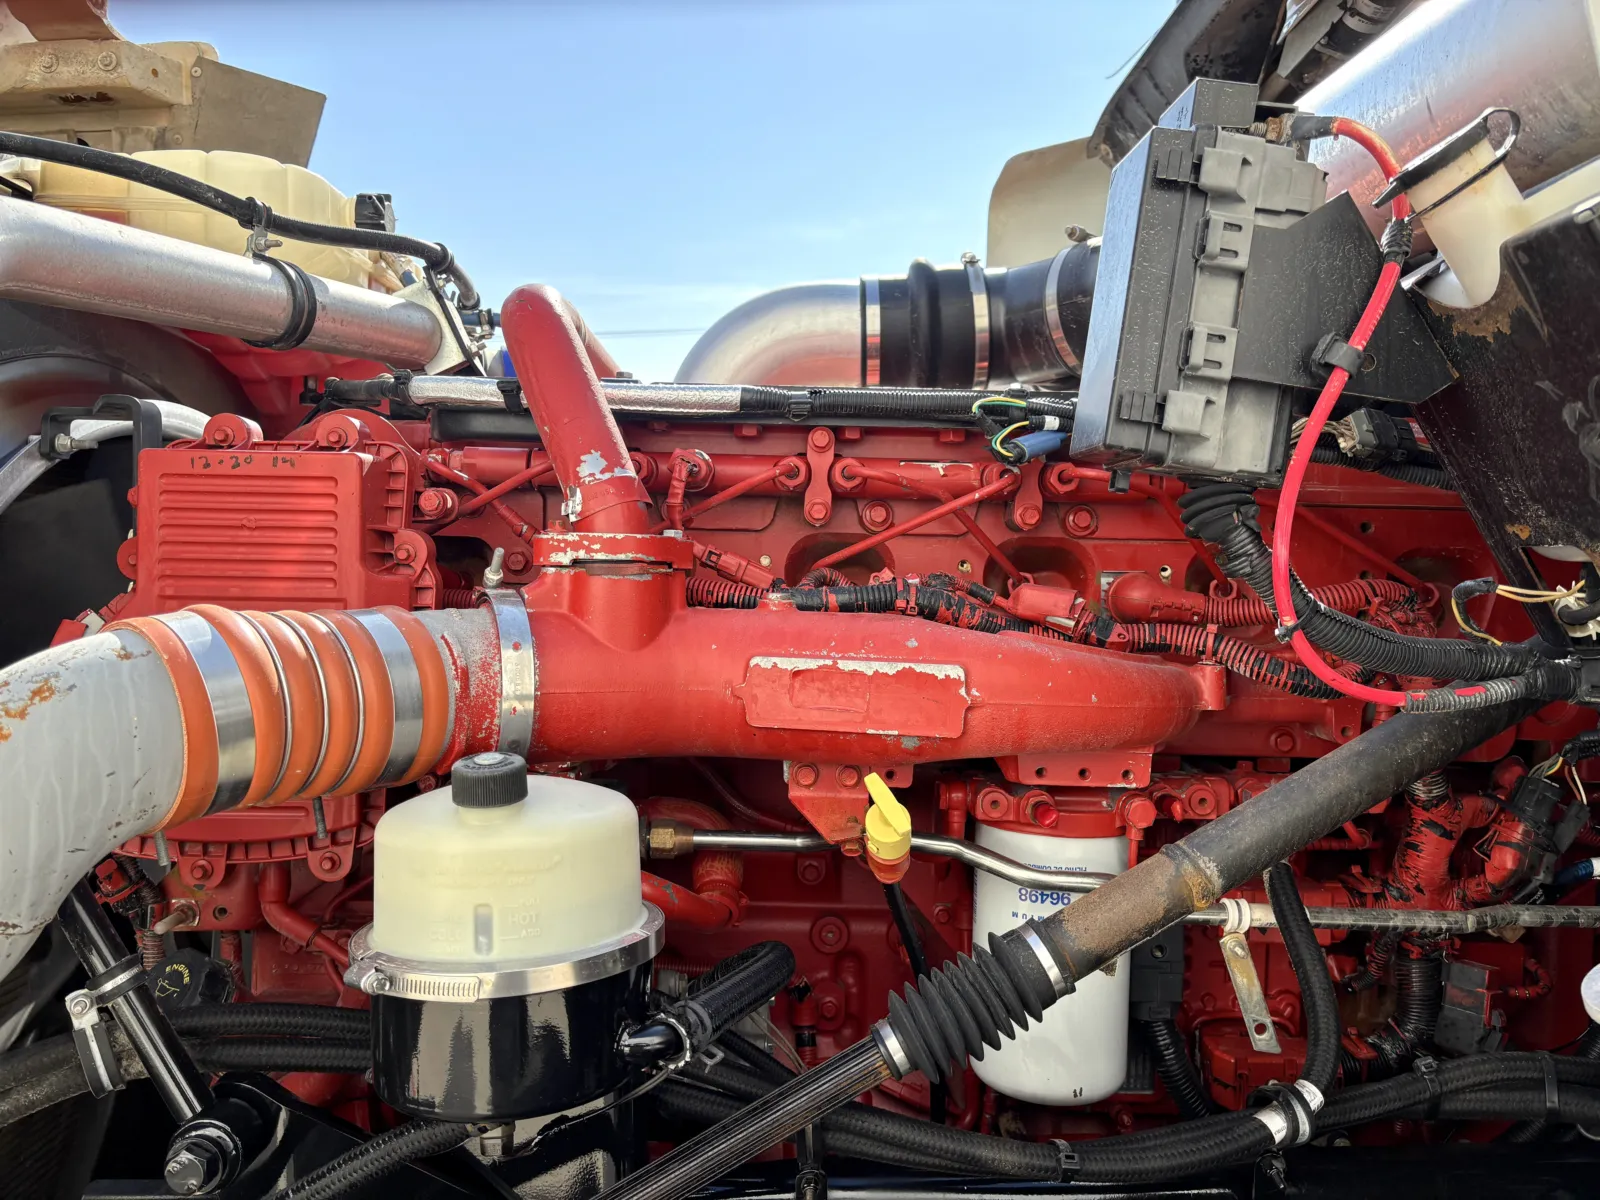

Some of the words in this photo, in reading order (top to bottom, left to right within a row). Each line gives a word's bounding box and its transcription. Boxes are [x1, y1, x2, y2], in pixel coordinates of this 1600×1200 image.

[1018, 887, 1071, 906] 96498
[510, 913, 538, 926] HOT
[165, 963, 191, 985] ENGINE
